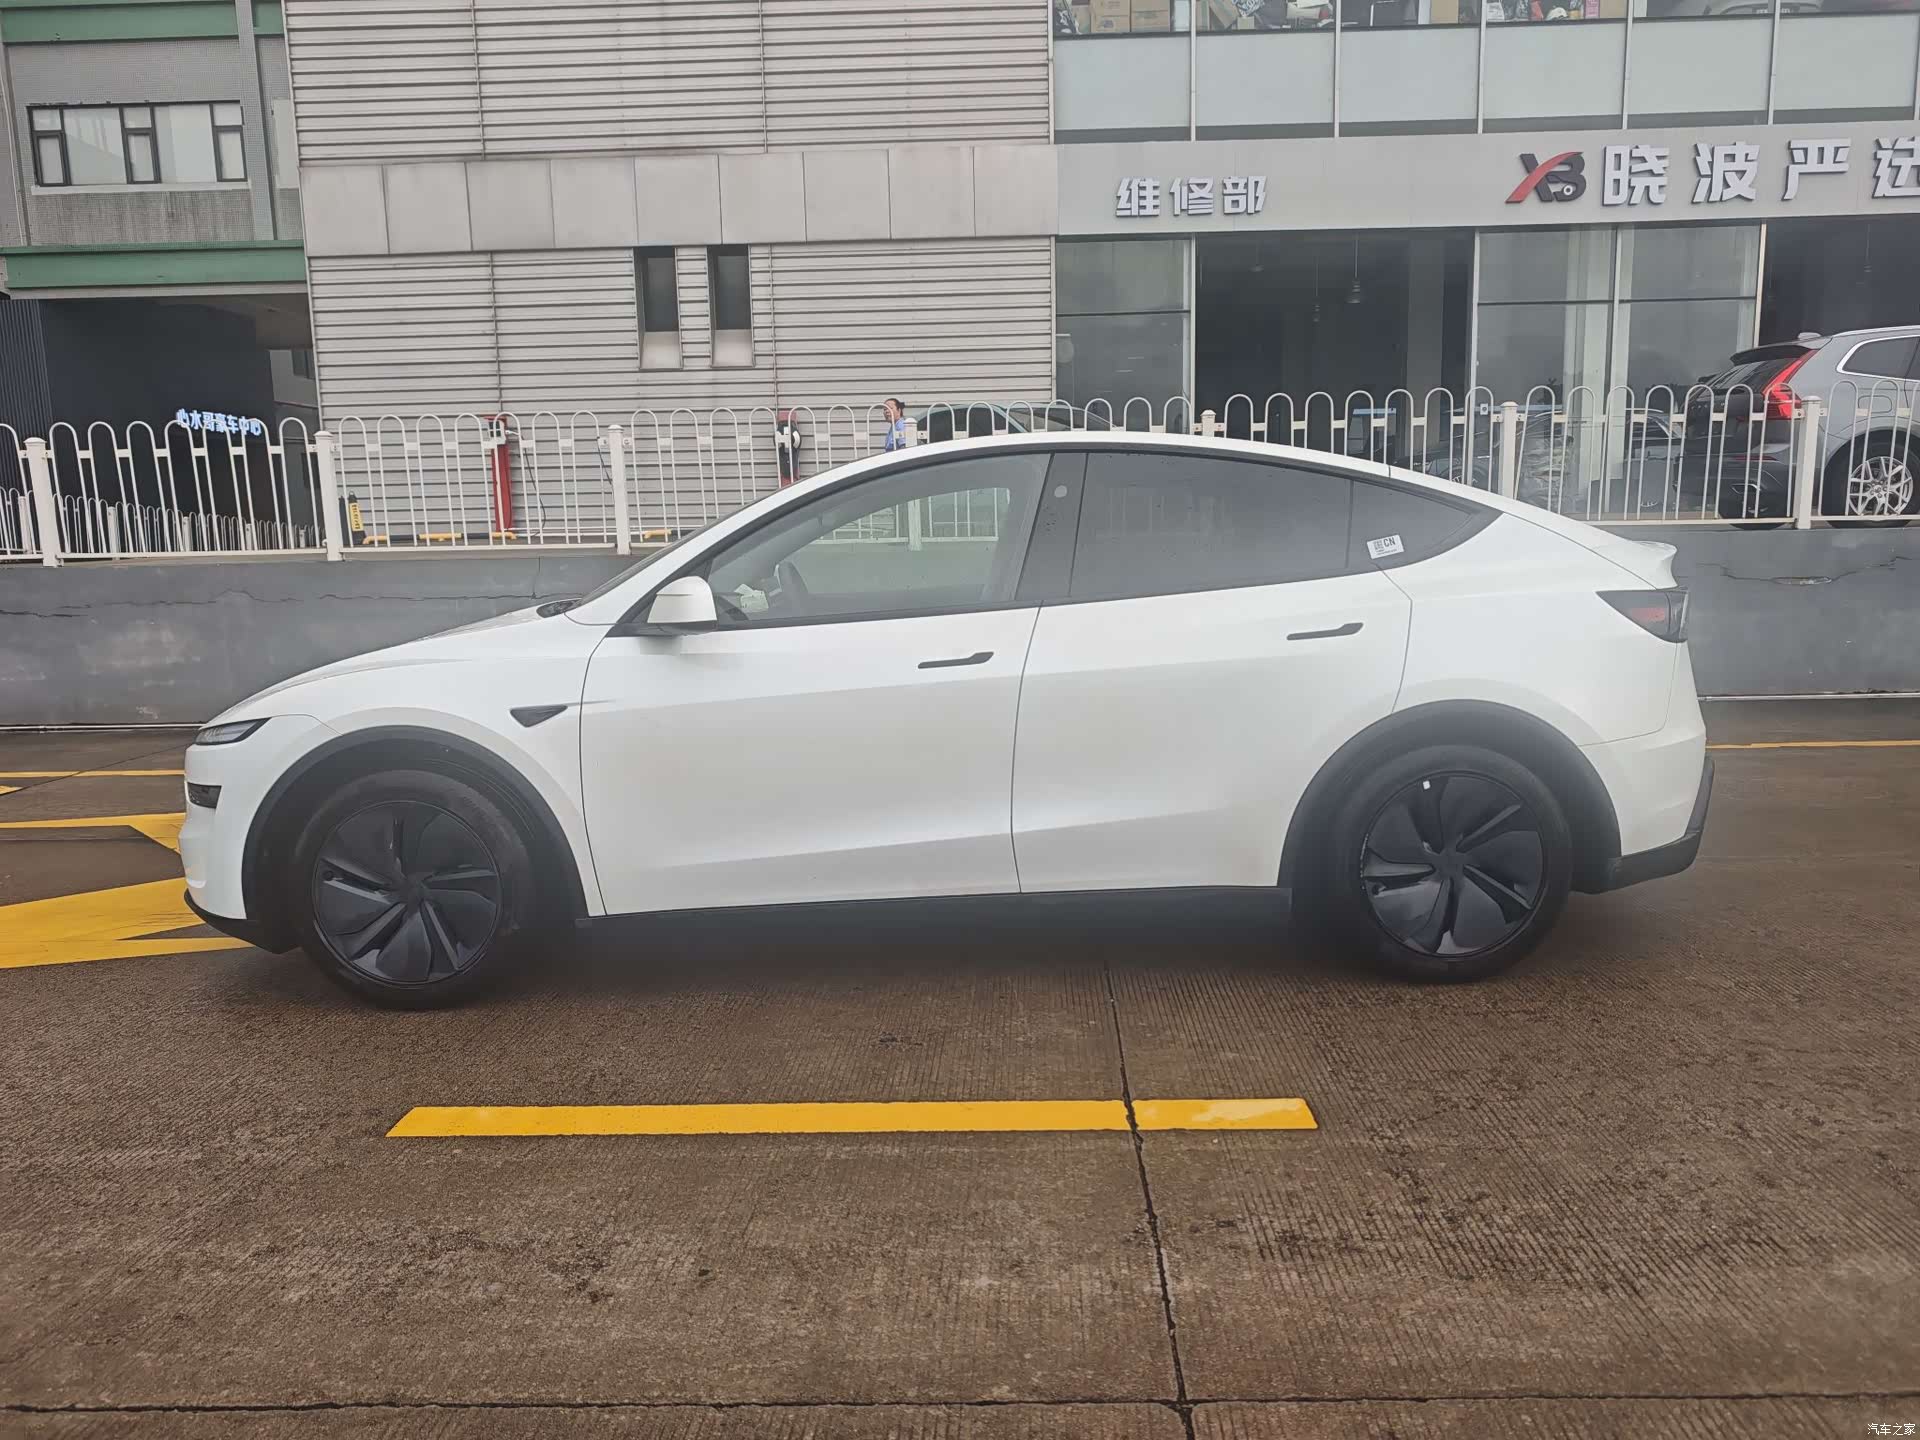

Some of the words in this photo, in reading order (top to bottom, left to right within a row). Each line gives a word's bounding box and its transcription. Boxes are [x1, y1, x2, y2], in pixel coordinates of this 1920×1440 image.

[1602, 136, 1920, 206] 晓波严选
[1115, 175, 1267, 218] 维修部
[1383, 536, 1396, 547] CN
